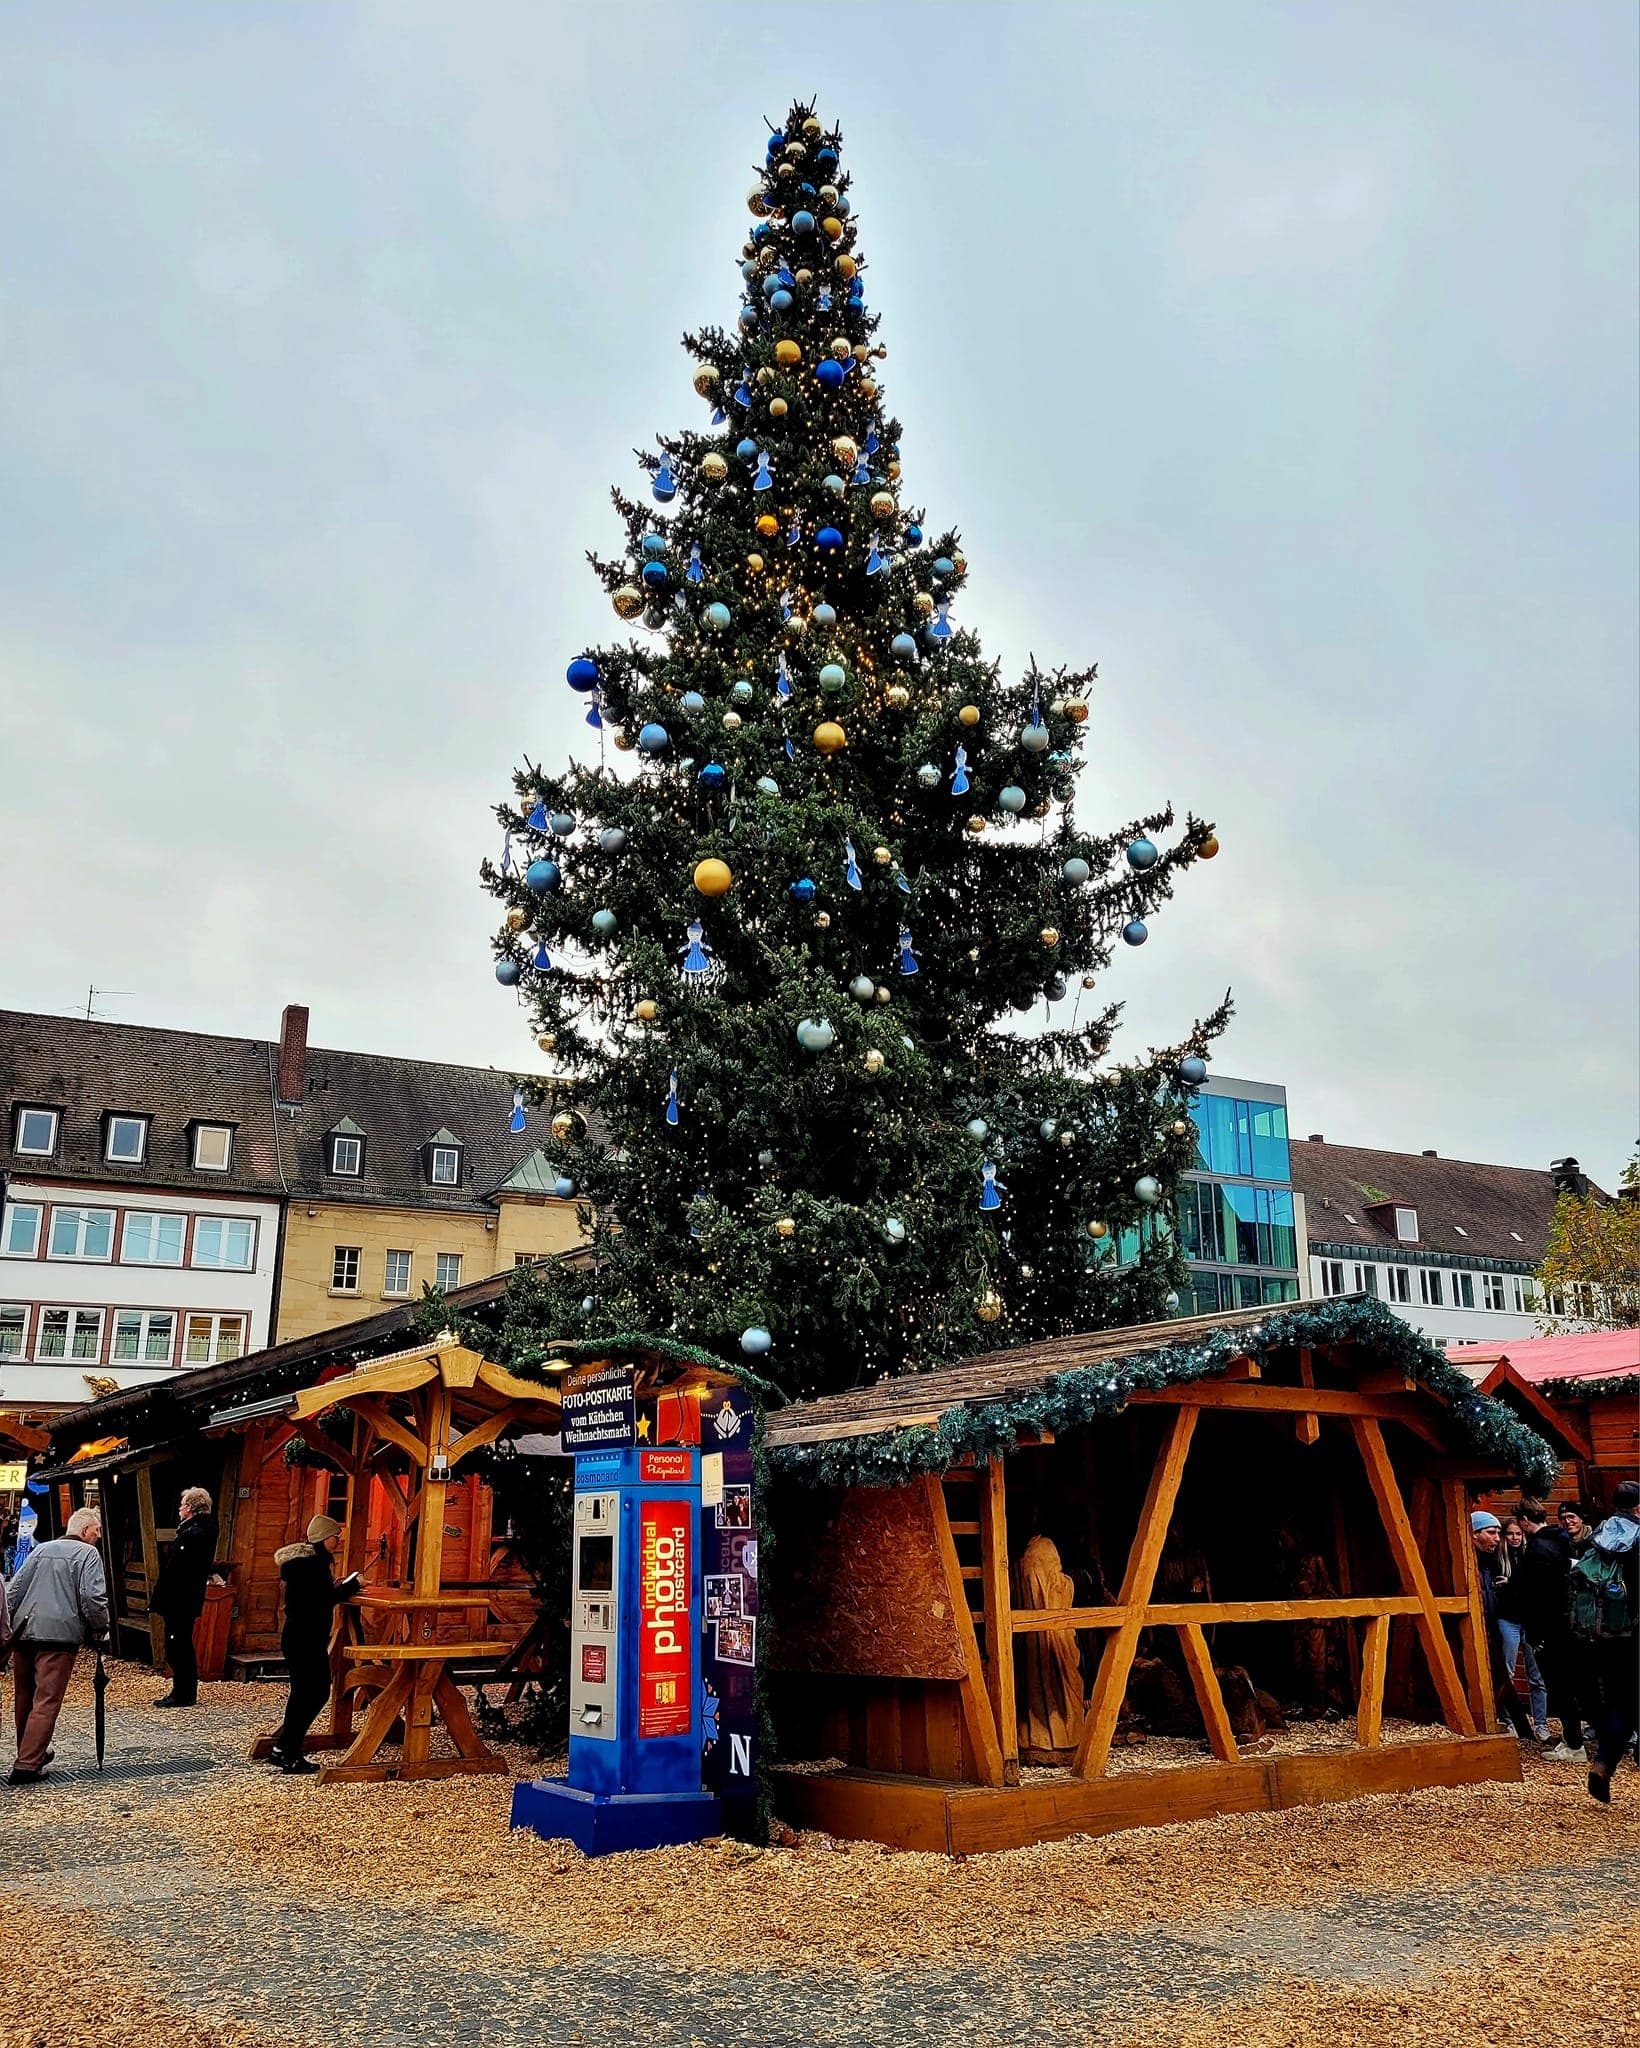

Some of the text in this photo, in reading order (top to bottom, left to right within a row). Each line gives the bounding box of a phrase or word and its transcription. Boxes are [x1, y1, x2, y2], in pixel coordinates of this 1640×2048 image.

[567, 1366, 627, 1387] Deine persönliche
[562, 1385, 633, 1410] FOTO-POSTKARTE
[571, 1409, 624, 1427] vom Käthchen
[565, 1424, 631, 1444] Weihnachtsmarkt
[648, 1454, 683, 1464] Personal
[642, 1521, 657, 1609] individual
[671, 1527, 688, 1613] postcard
[647, 1537, 682, 1654] photo
[729, 1733, 752, 1777] N
